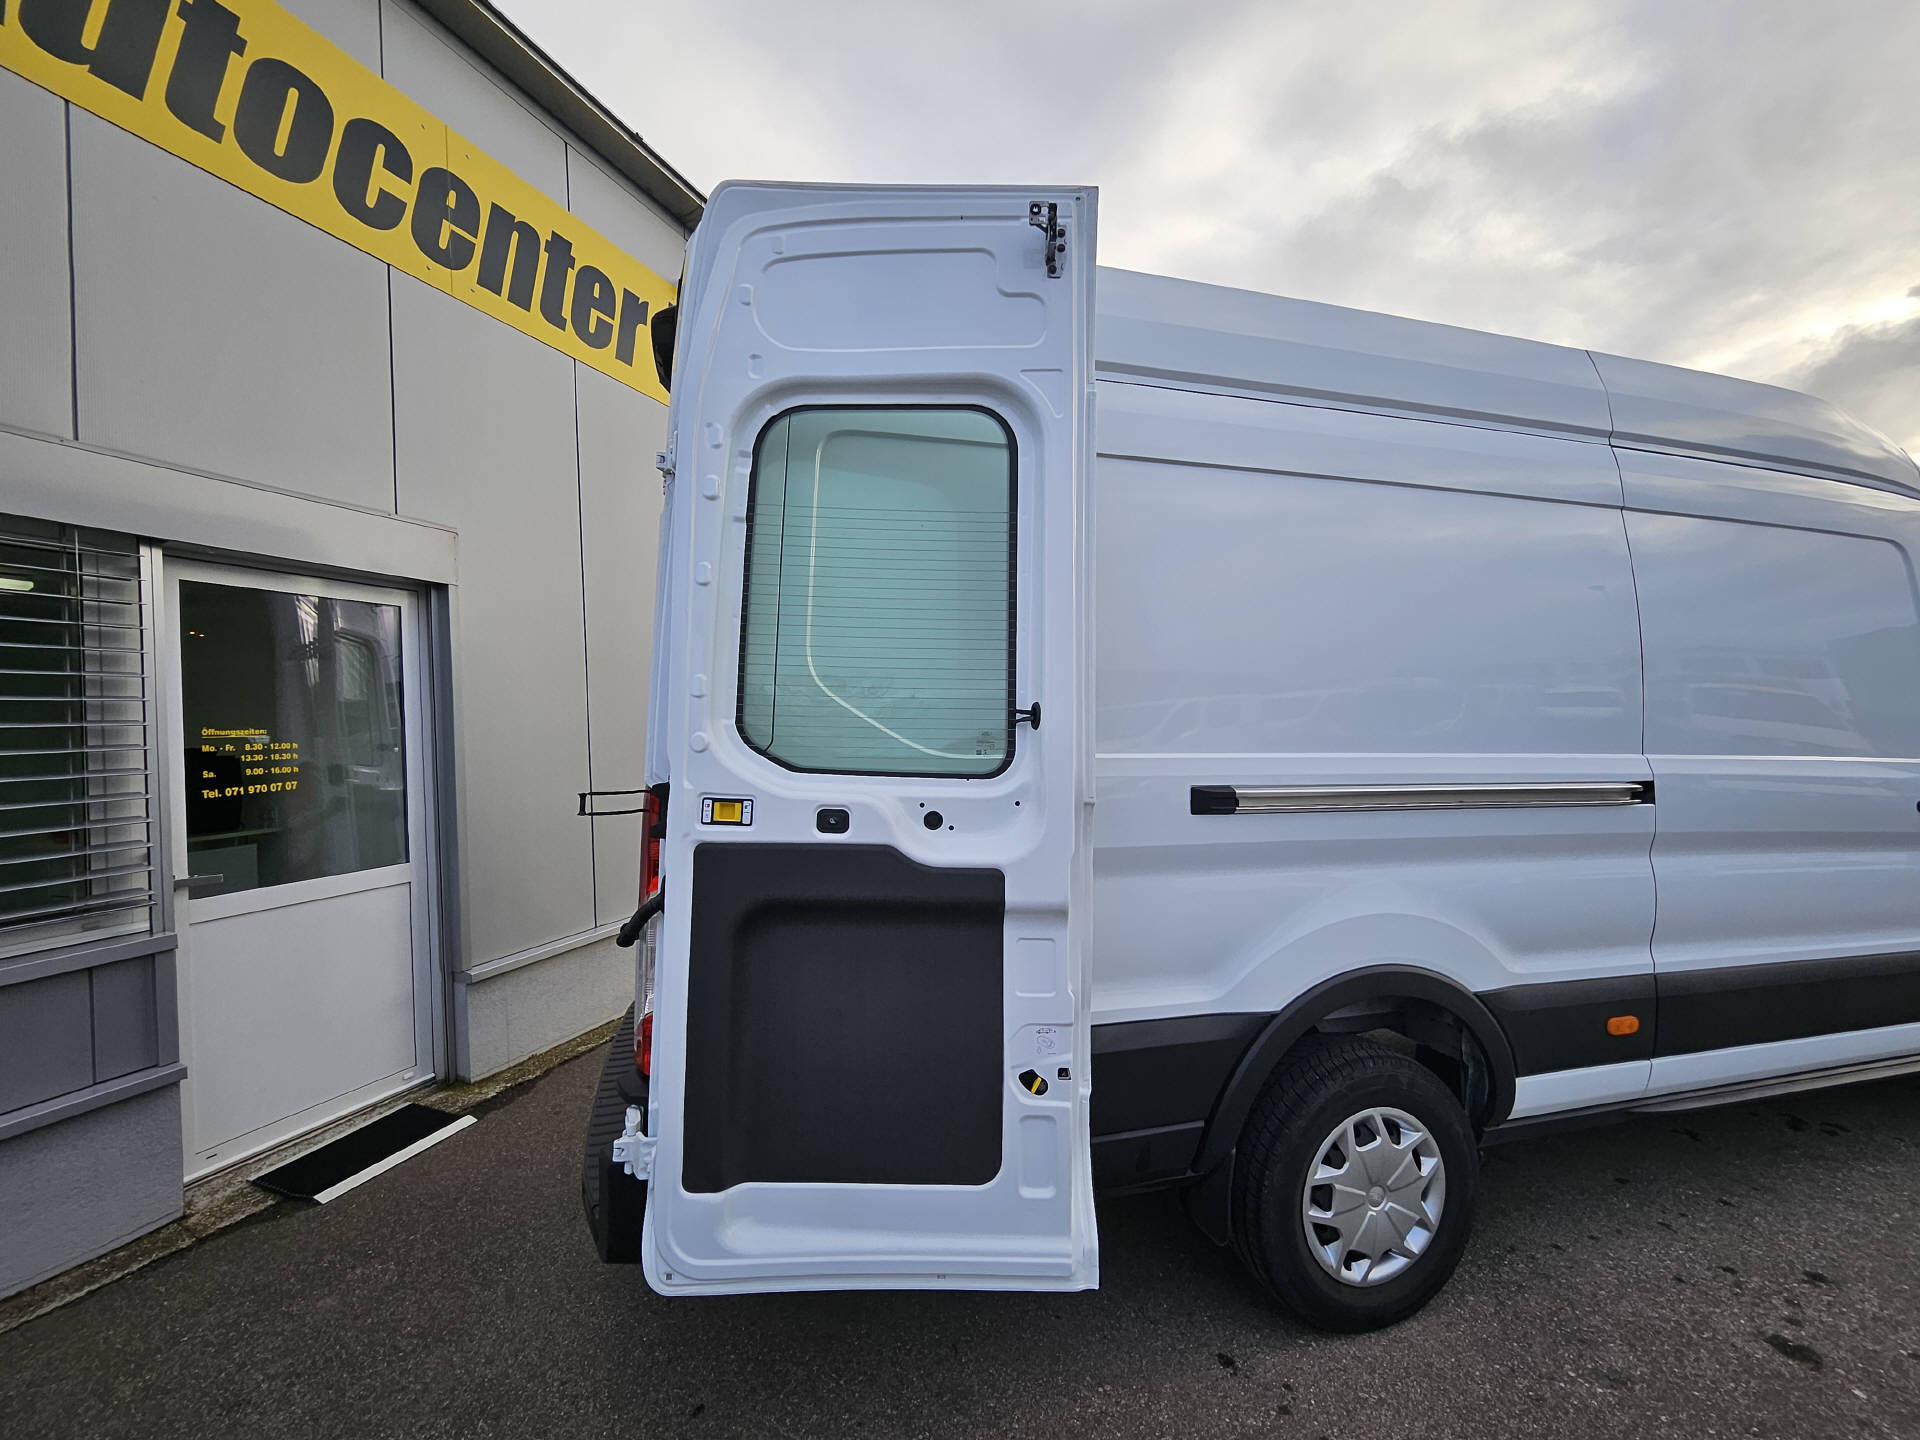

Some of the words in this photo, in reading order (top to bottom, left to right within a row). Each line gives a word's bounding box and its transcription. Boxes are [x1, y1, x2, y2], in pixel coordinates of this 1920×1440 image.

[0, 0, 649, 367] utocenter
[201, 728, 267, 736] Öffnungszeiten:
[225, 744, 236, 752] Fr.
[244, 743, 263, 751] 8.30
[241, 754, 263, 762] 13.30
[202, 770, 217, 779] Sa.
[245, 767, 264, 776] 9.00
[271, 766, 291, 775] 16.00
[201, 789, 222, 798] Tel.
[225, 787, 244, 796] 071
[248, 784, 268, 793] 970
[270, 782, 283, 792] 07
[285, 781, 298, 790] 07
